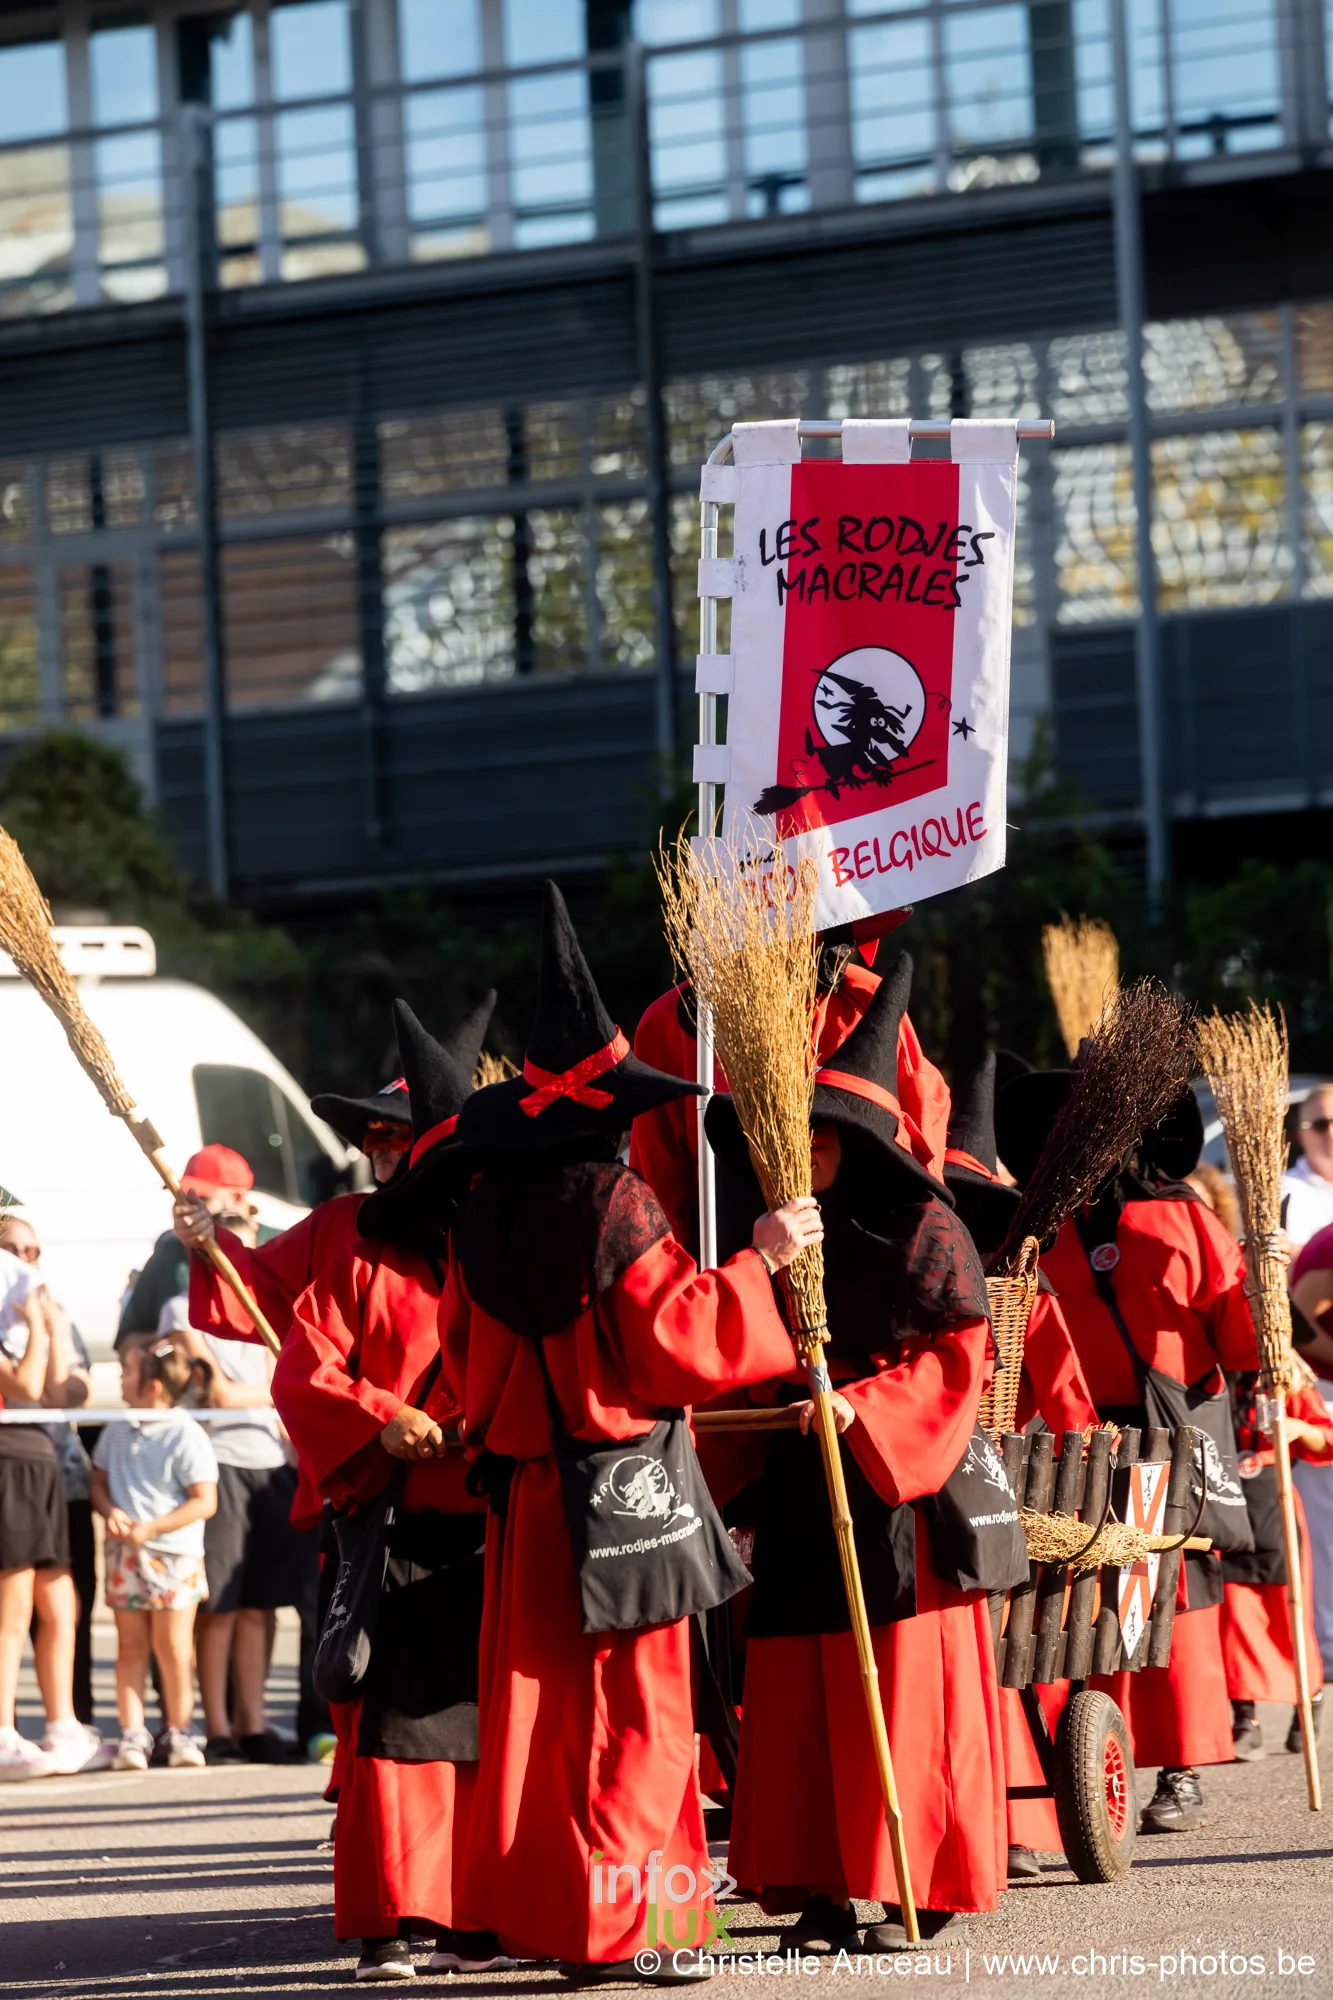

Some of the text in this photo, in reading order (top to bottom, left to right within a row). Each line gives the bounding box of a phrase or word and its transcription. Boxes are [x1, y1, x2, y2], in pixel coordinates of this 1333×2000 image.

[760, 516, 995, 565] LES RODJES
[778, 563, 968, 609] MACRALES
[829, 802, 988, 887] BELGIQUE
